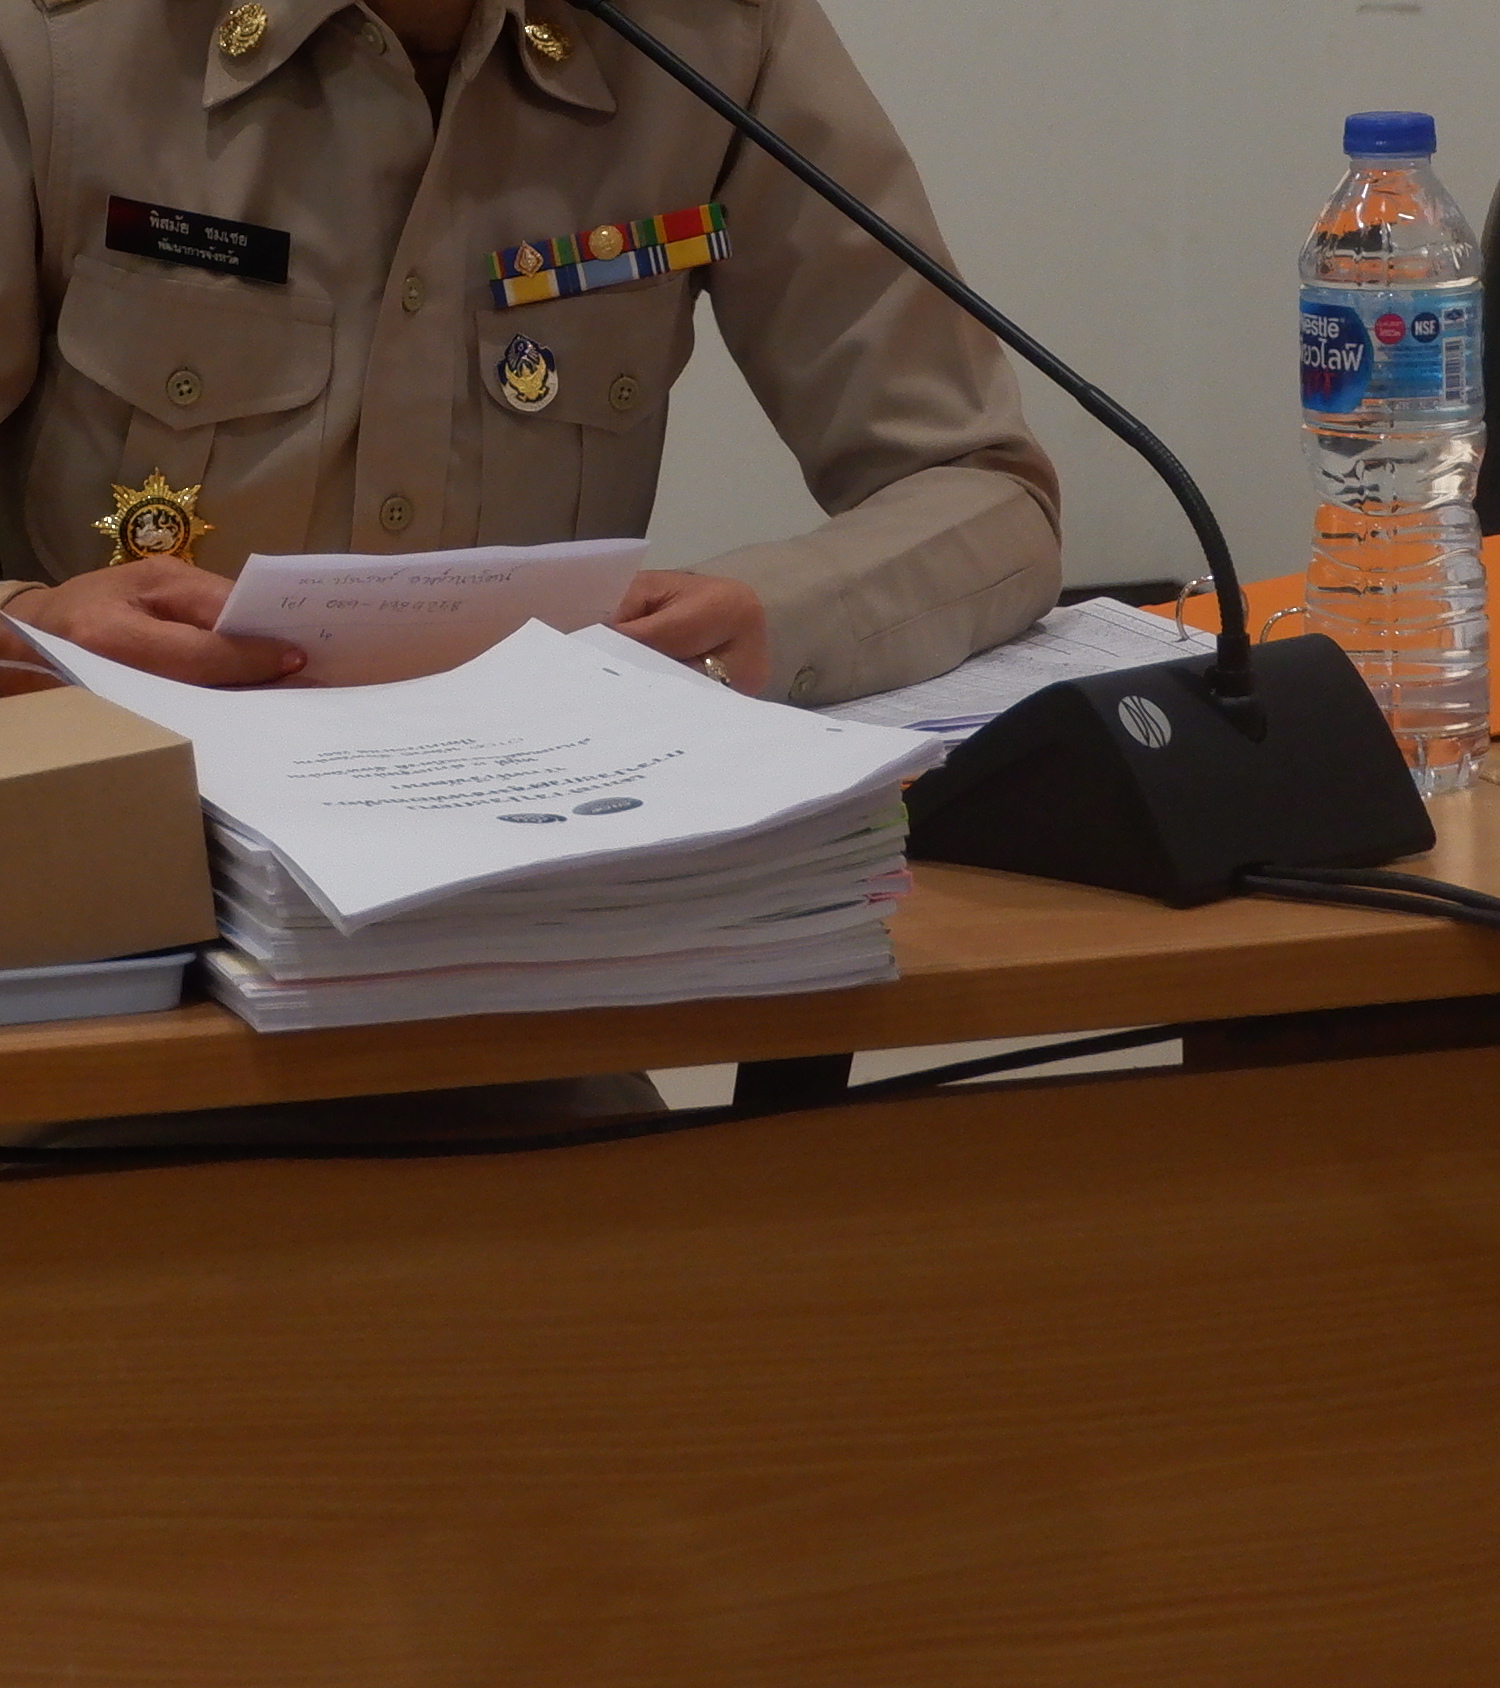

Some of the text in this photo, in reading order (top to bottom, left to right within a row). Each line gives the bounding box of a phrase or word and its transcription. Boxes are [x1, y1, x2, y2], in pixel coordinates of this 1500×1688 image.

[149, 209, 190, 235] พิสมัย
[1301, 313, 1340, 339] estlé
[1415, 320, 1437, 336] NSF
